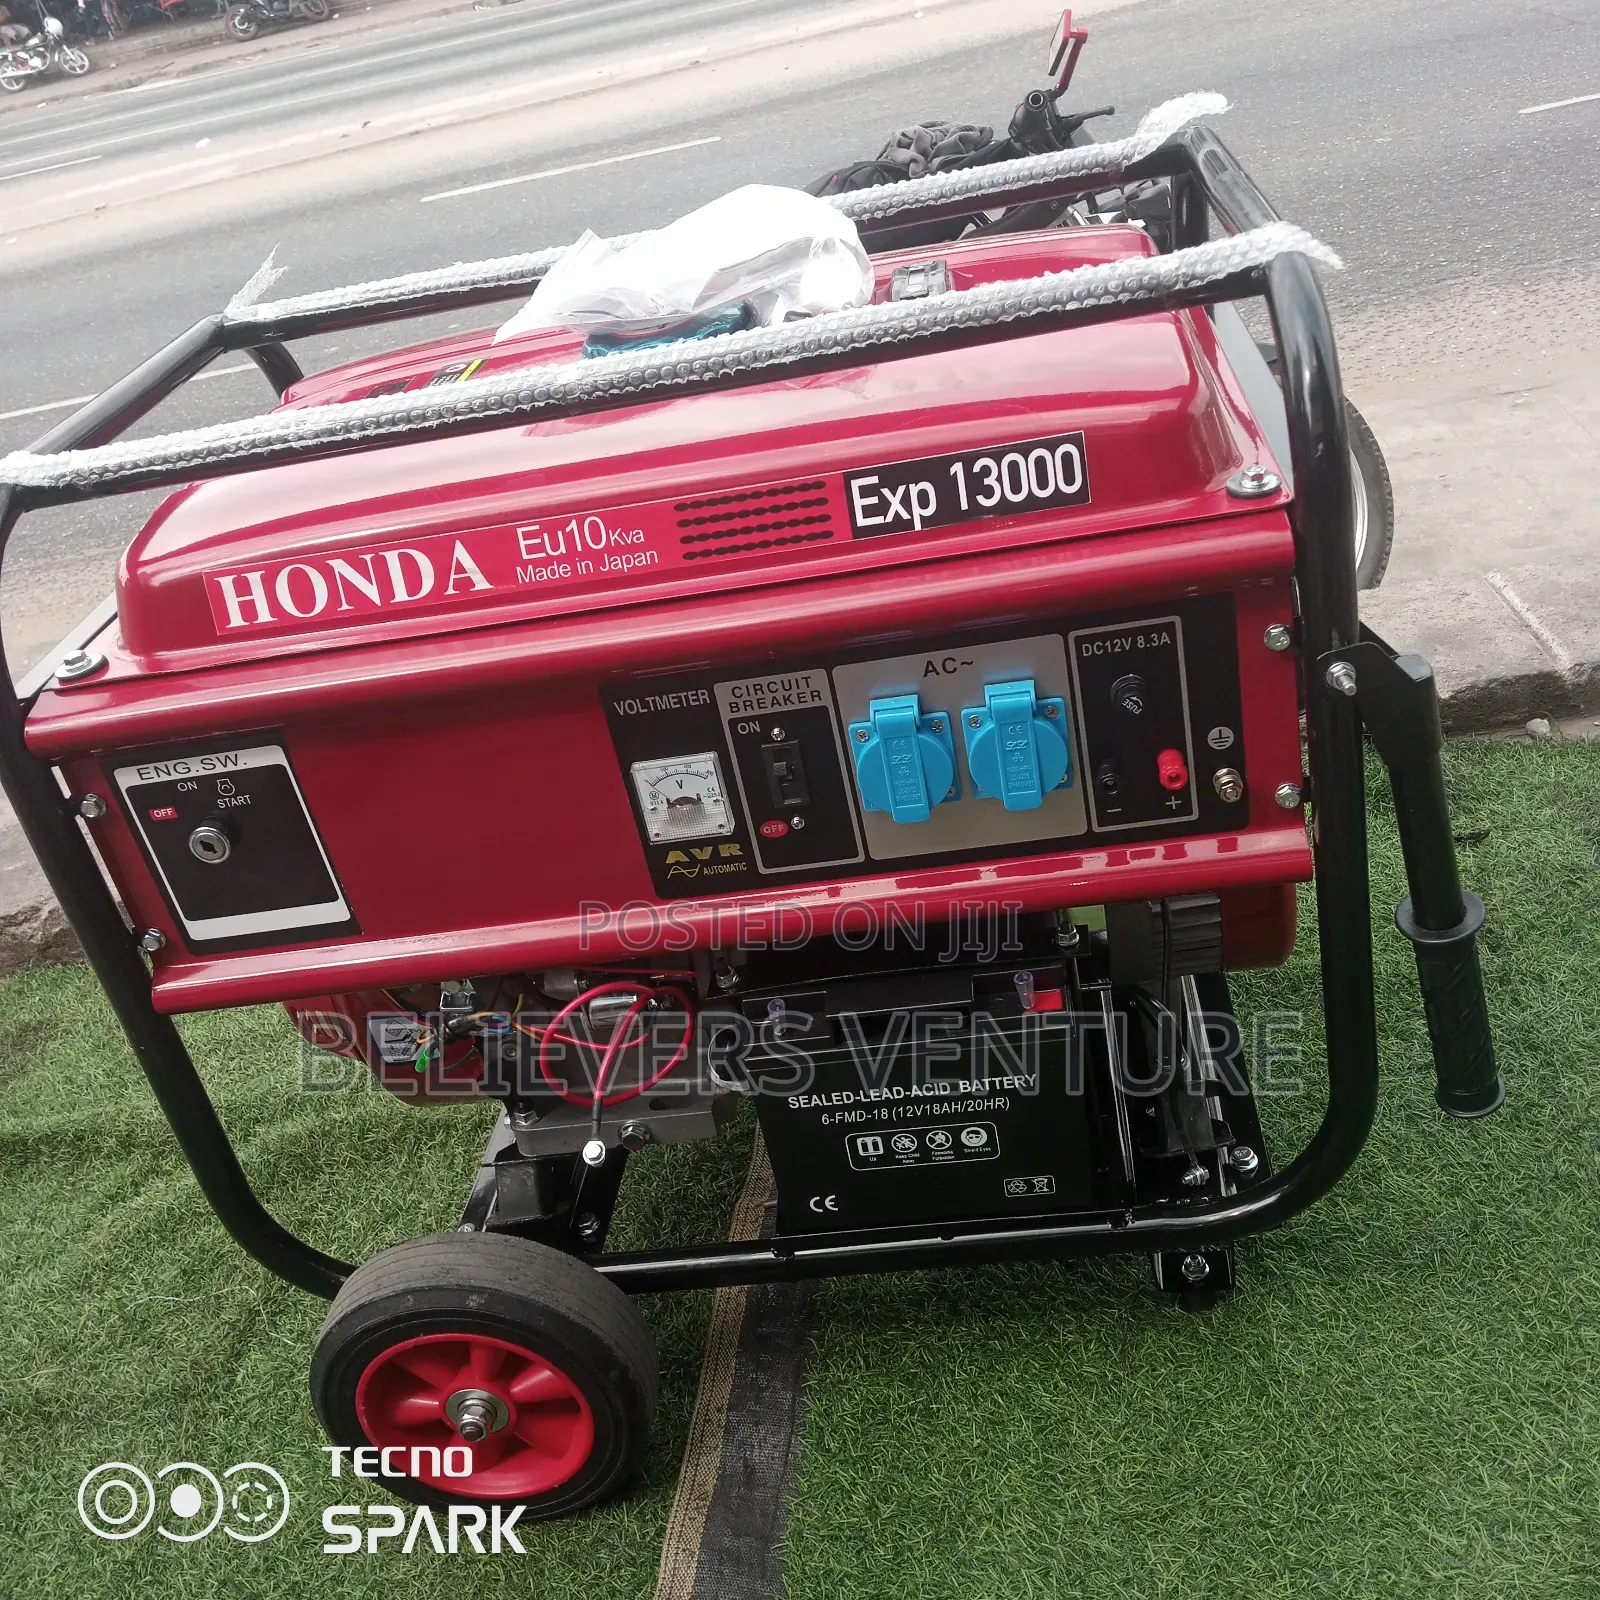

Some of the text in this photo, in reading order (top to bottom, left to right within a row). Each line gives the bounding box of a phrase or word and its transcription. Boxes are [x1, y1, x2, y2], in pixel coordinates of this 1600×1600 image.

[850, 443, 1083, 530] Exp 13000
[515, 548, 658, 584] Made in Japan
[214, 539, 494, 629] HONDA
[1082, 631, 1170, 657] DC12V 8.3A
[731, 676, 813, 699] CIRCUIT
[613, 689, 711, 716] VOLTMETER
[728, 689, 823, 714] BREAKER
[1121, 698, 1143, 715] FUSE
[737, 721, 761, 735] ON
[137, 753, 248, 780] ENG.SW.
[177, 781, 198, 792] ON
[676, 779, 683, 789] V
[217, 794, 252, 809] START
[153, 808, 173, 818] OFF
[763, 824, 785, 834] OFF
[665, 843, 743, 863] AVR
[703, 862, 748, 875] AUTOMATIC
[787, 1073, 1037, 1109] SEALED-LEAD-ACID BATTERY
[821, 1096, 1010, 1125] 6-FMD-18 (12V18AH/20HR)
[809, 1195, 839, 1212] CE
